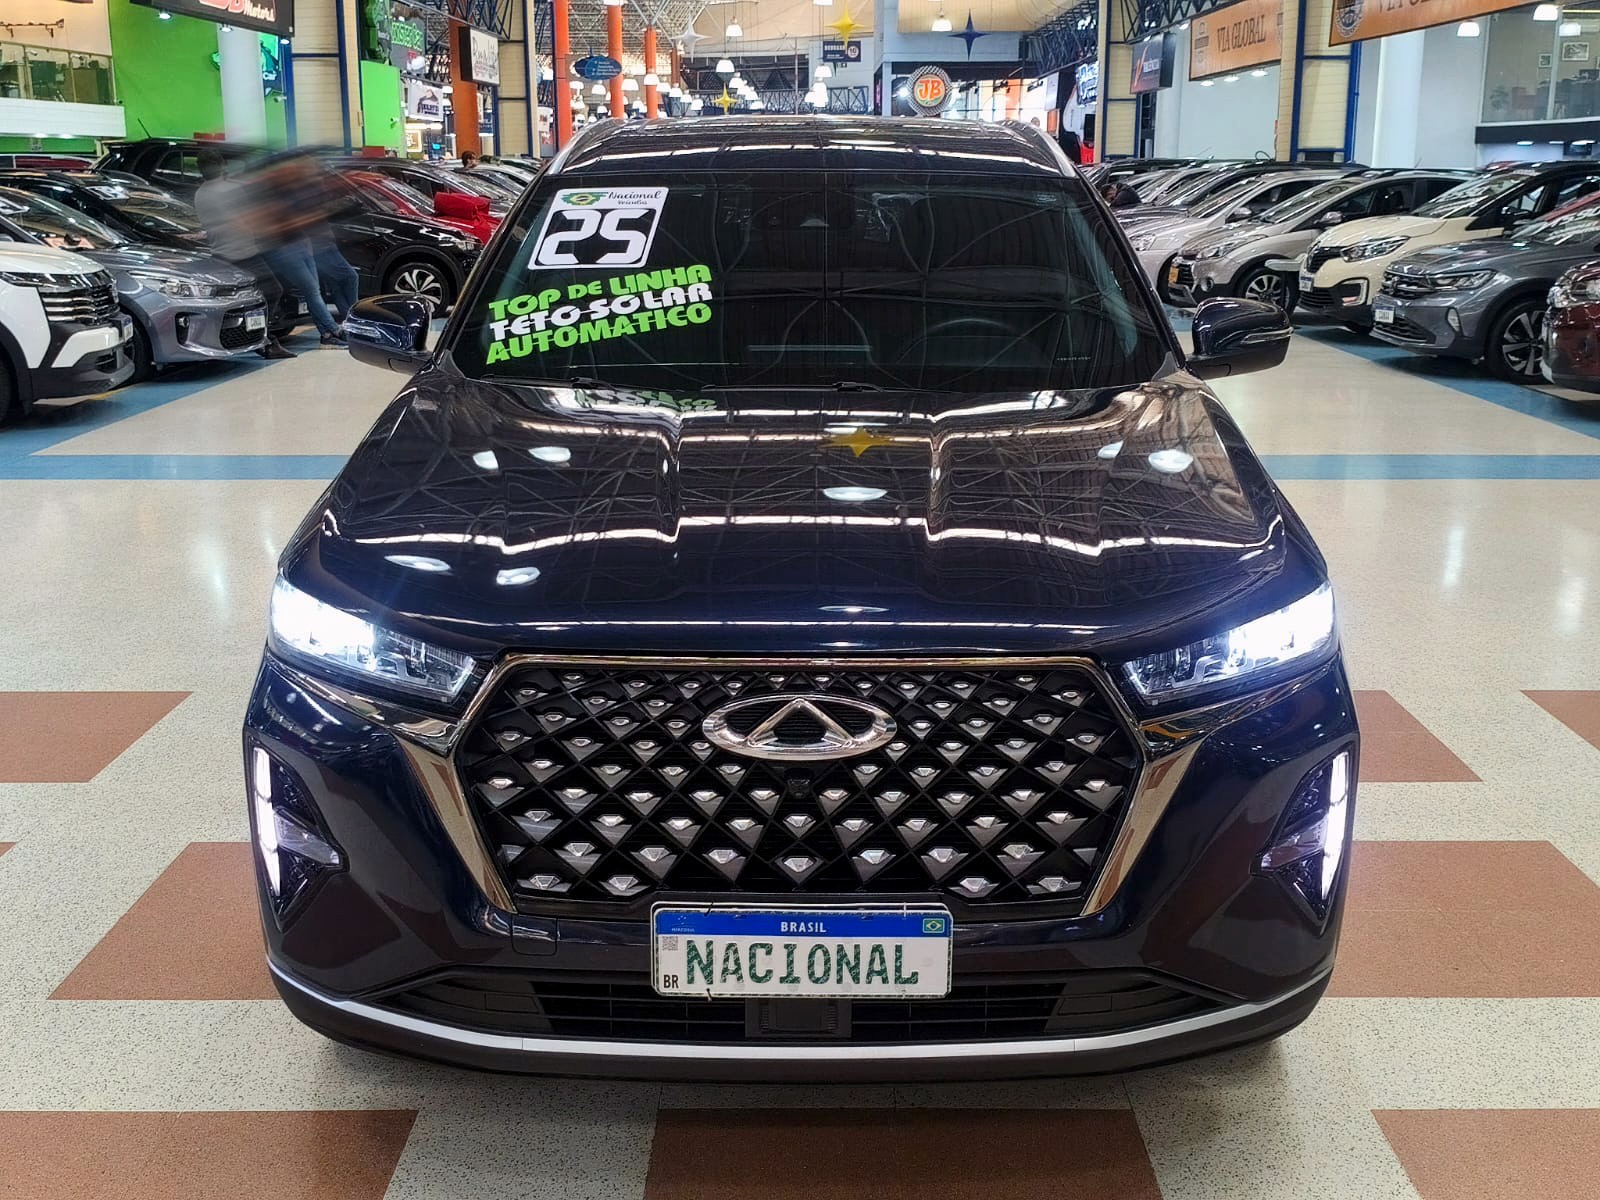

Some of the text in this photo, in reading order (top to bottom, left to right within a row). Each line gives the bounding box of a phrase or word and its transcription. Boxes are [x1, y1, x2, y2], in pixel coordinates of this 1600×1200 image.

[1217, 15, 1266, 52] VIA GLOBAL
[918, 79, 943, 100] JB
[608, 190, 661, 199] Nacional
[538, 209, 649, 265] 25
[488, 265, 712, 321] TOP DE LINHA
[490, 283, 713, 341] TETO SOLAR
[486, 303, 712, 365] AUTOMATICO
[780, 921, 826, 933] BRASIL
[663, 974, 679, 989] BR
[686, 939, 919, 985] NACIONAL
